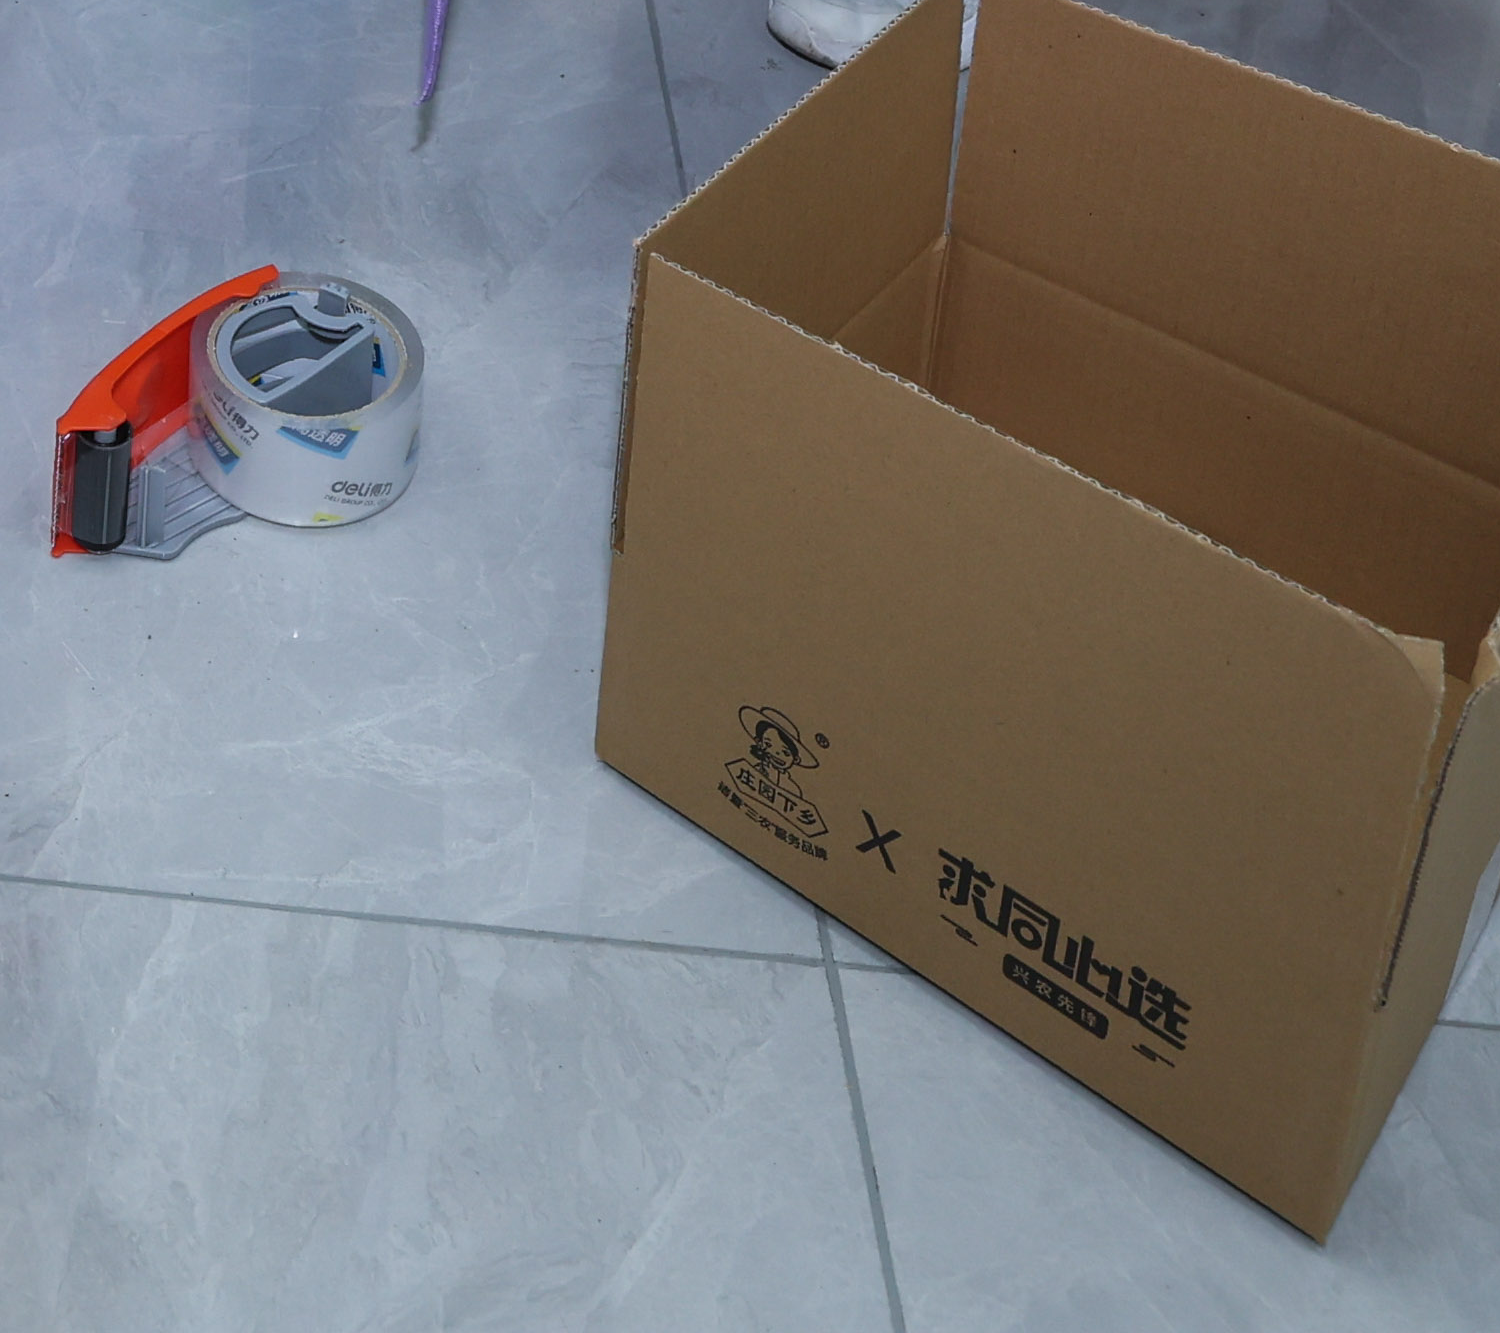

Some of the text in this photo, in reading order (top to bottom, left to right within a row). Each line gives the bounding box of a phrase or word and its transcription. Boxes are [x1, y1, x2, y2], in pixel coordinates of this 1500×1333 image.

[735, 767, 817, 827] 庄园下乡
[1011, 961, 1098, 1029] 兴农先锋
